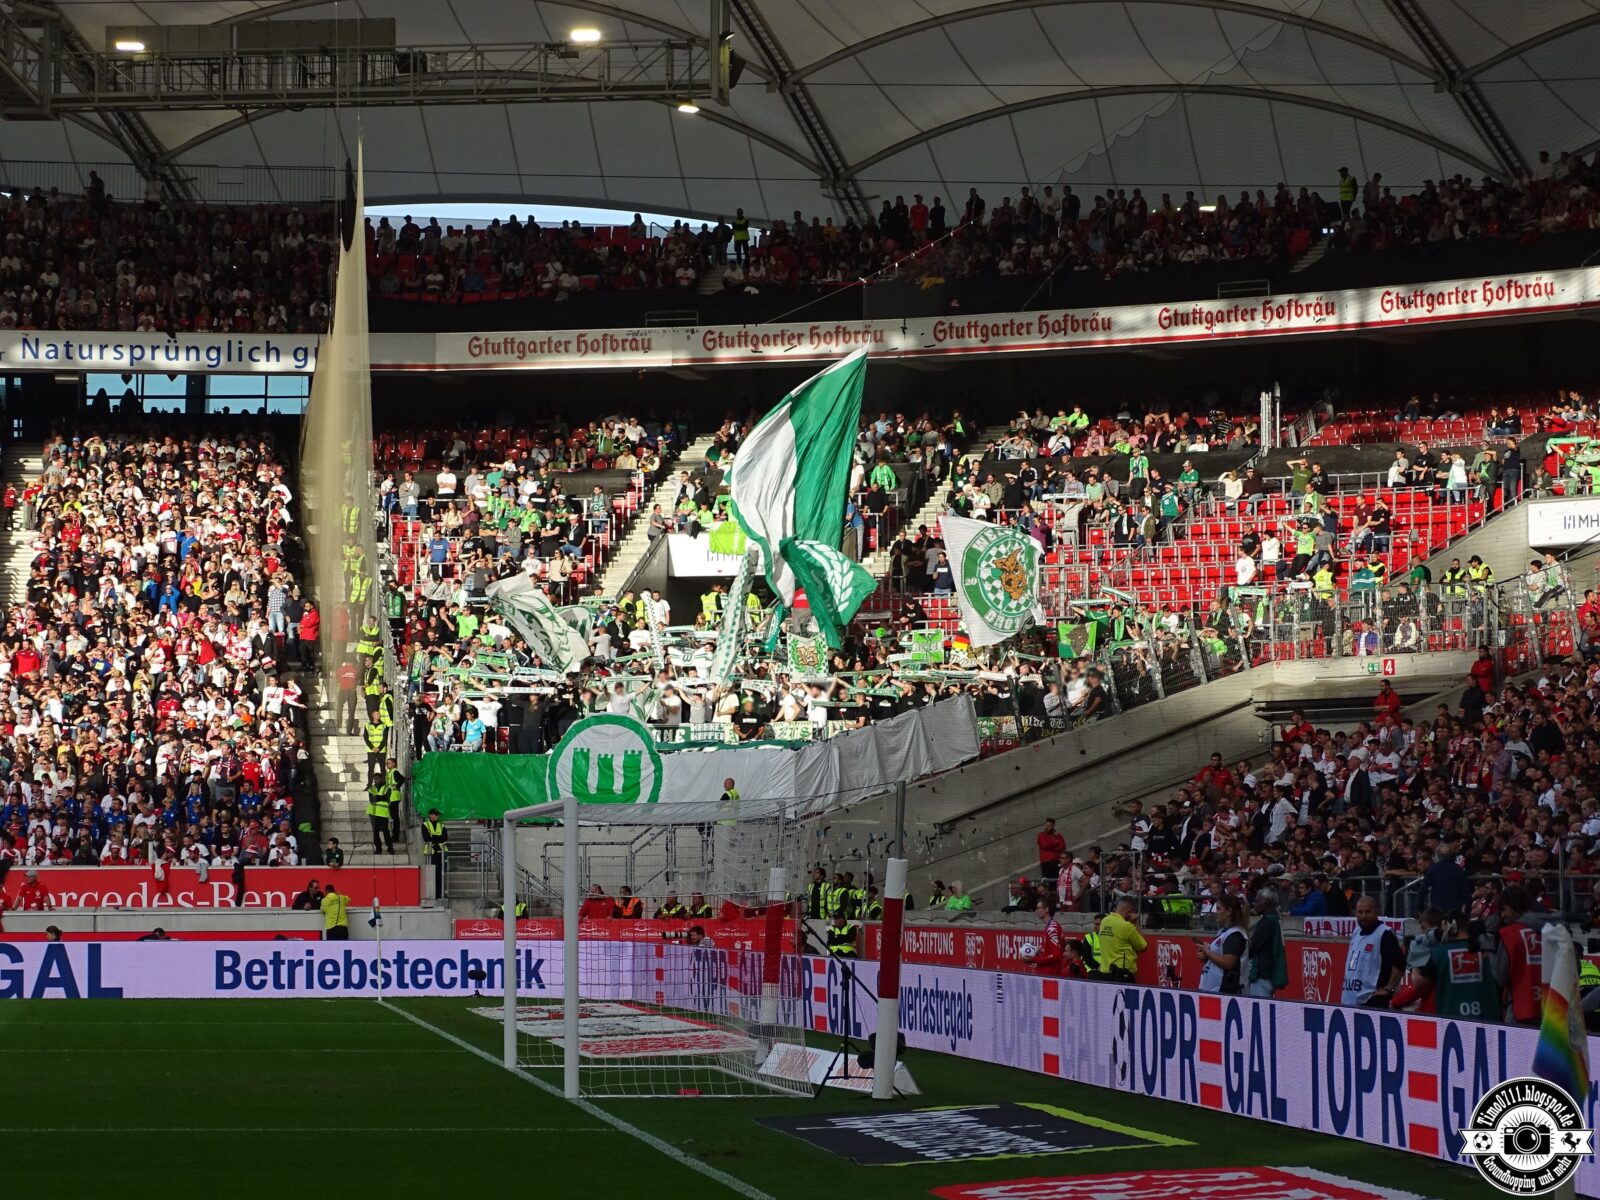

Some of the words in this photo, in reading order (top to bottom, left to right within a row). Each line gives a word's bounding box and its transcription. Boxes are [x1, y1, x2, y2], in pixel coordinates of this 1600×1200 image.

[1157, 304, 1256, 330] Stuttgarter
[1261, 296, 1336, 323] Hofbräu
[1380, 289, 1477, 315] Stuttgarter
[1483, 279, 1555, 307] Hofbräu
[703, 329, 805, 355] Stuttgarter
[810, 324, 886, 350] Hofbräu
[933, 318, 1033, 344] Stuttgarter
[1037, 312, 1112, 339] Hofbräu
[22, 336, 281, 368] Natursprünglich
[293, 346, 318, 368] g
[468, 334, 572, 360] Stuttgarter
[577, 331, 652, 357] Hofbräu
[1385, 659, 1394, 676] 4
[47, 880, 302, 907] rcedes-Ben
[904, 930, 954, 956] VfB-STIFTUNG
[215, 949, 546, 990] Betriebstechnik
[776, 955, 862, 1038] OPREGAL
[1459, 1001, 1481, 1016] 08
[1125, 989, 1287, 1122] TOPREGAL
